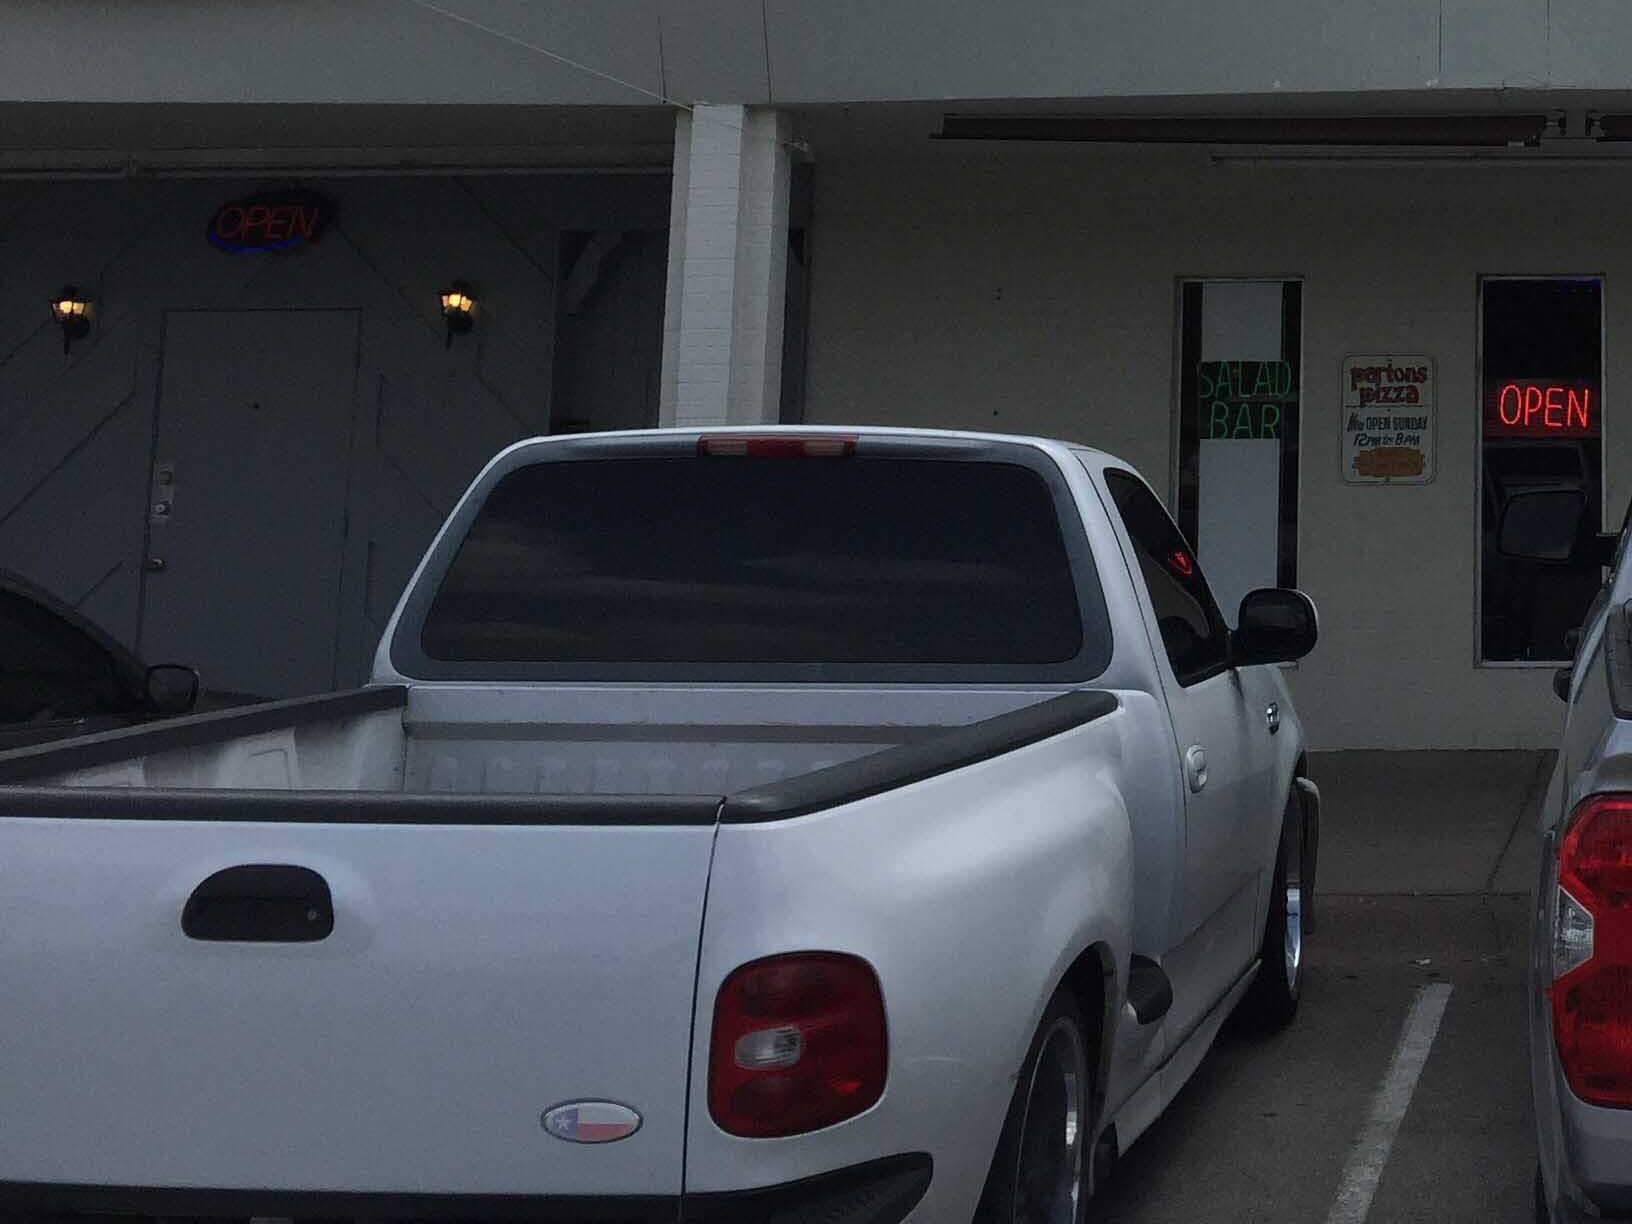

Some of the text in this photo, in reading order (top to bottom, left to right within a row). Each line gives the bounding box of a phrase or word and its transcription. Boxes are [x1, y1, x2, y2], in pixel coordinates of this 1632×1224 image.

[216, 206, 319, 240] OPEN
[1351, 364, 1427, 392] partons
[1360, 383, 1419, 407] pizza
[1500, 384, 1589, 427] OPEN
[1210, 400, 1280, 439] BAR
[1366, 416, 1390, 430] OPEN
[1393, 416, 1427, 430] SUNDAY
